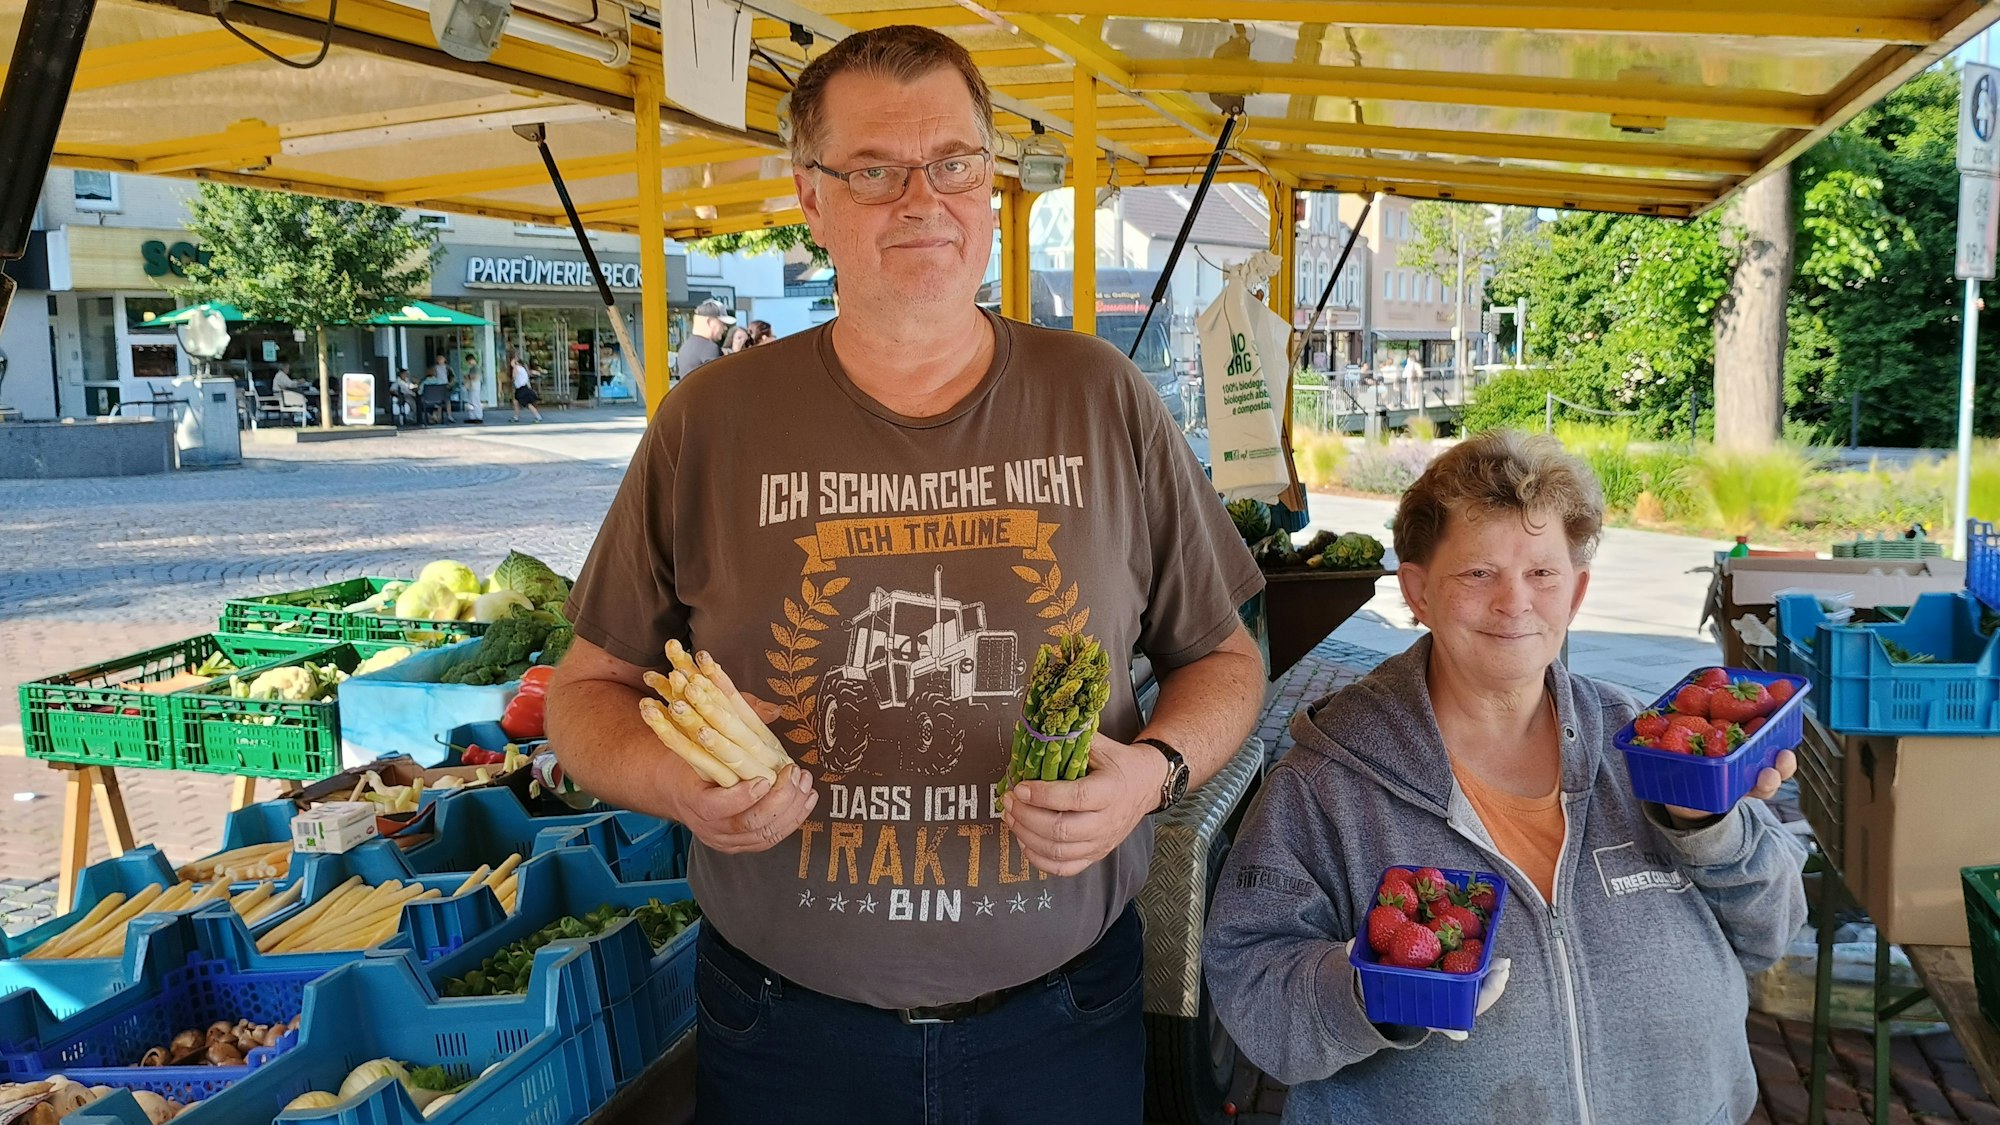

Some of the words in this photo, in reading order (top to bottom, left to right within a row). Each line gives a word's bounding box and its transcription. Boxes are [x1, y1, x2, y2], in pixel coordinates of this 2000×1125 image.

[467, 254, 593, 287] PARFÜMERIE
[1223, 391, 1255, 406] biologisch
[1238, 378, 1267, 392] biodegr
[759, 471, 809, 528] ICH
[819, 465, 998, 516] SCHNARCHE
[1004, 454, 1085, 509] NICHT
[845, 526, 893, 555] ICH
[904, 516, 1012, 549] TRÄUME
[829, 783, 912, 822] DASS
[924, 783, 979, 822] ICH
[798, 820, 1048, 888] TRAKTO
[1610, 870, 1652, 891] STREET
[888, 888, 963, 923] BIN
